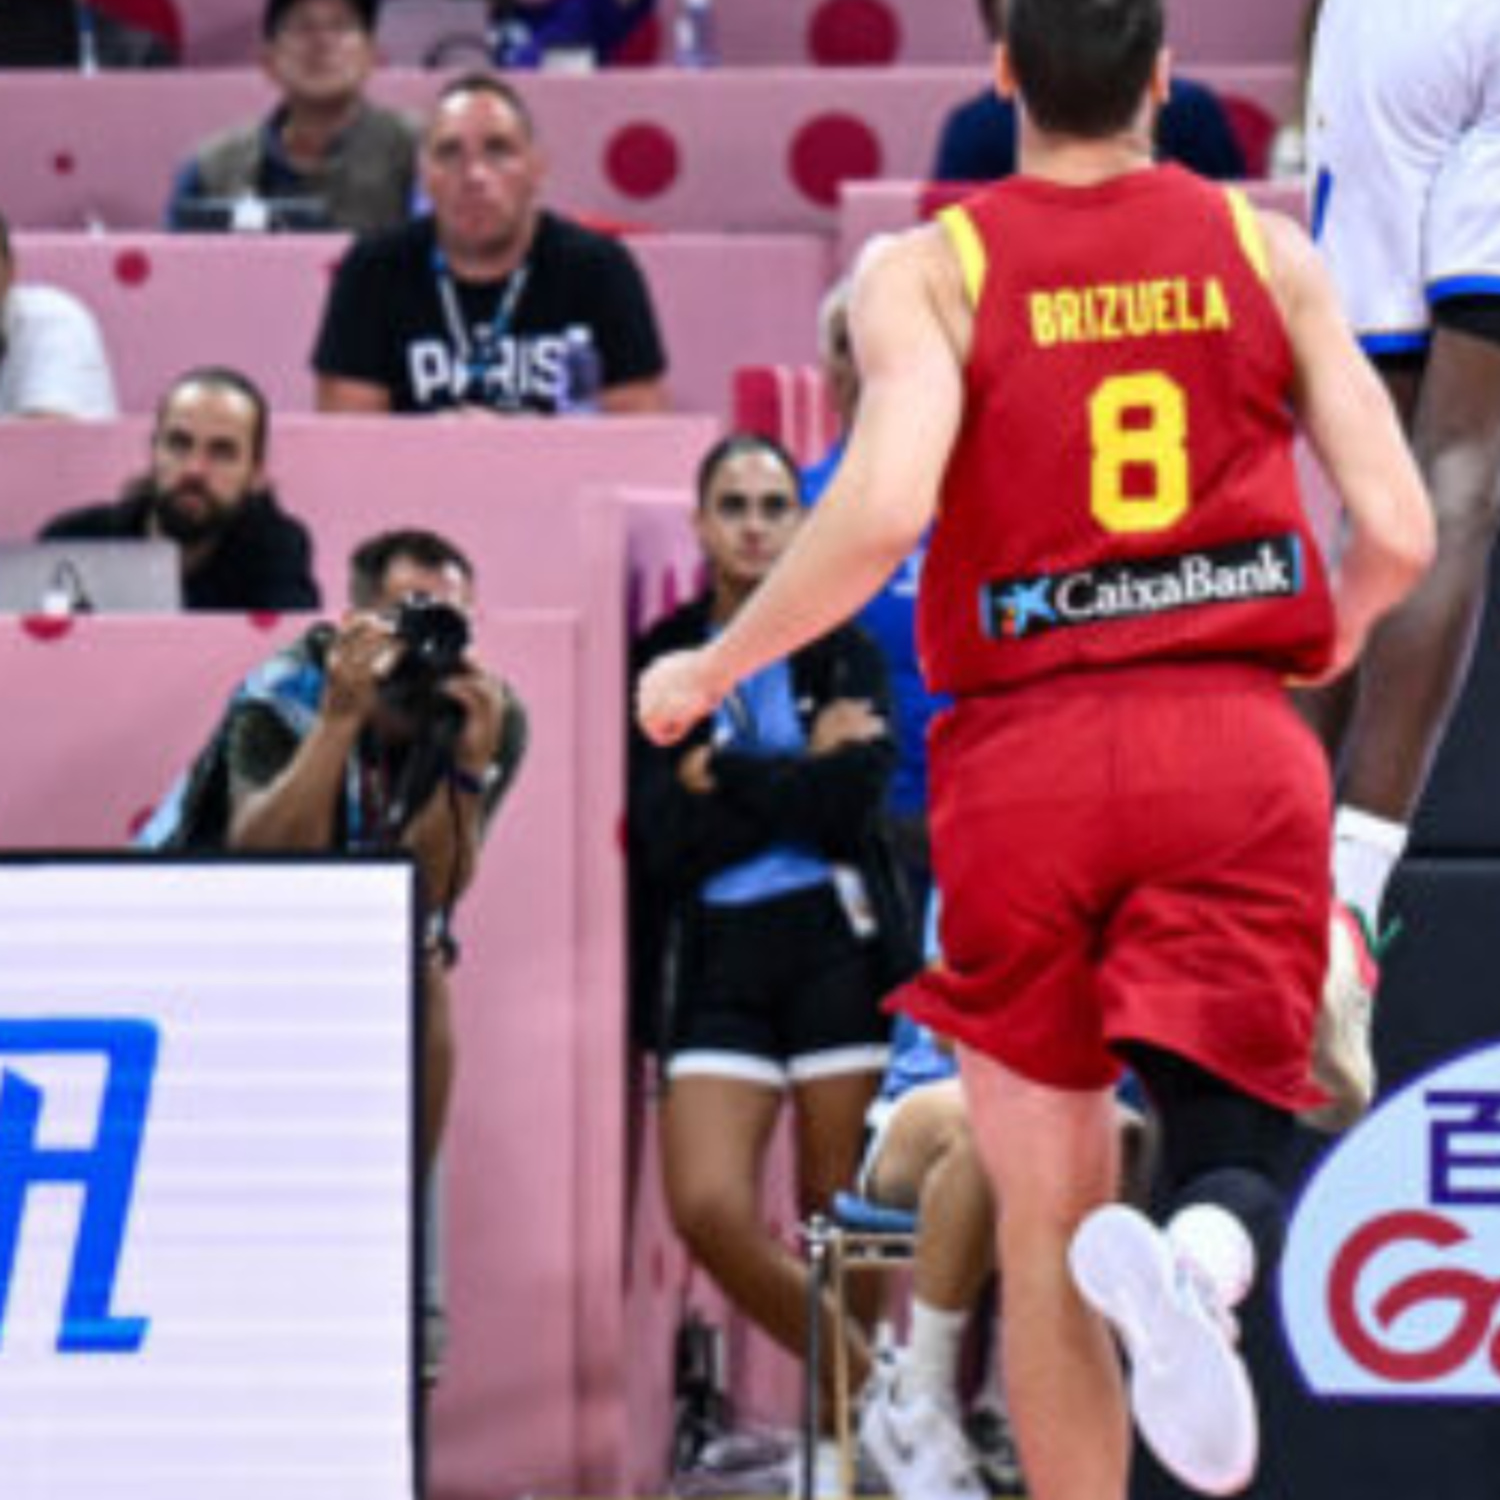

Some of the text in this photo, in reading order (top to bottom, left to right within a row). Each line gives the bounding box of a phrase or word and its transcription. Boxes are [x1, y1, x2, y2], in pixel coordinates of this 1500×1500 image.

[1030, 276, 1232, 348] BRIZUELA
[1088, 370, 1190, 533] 8
[1055, 543, 1291, 618] CaixaBank
